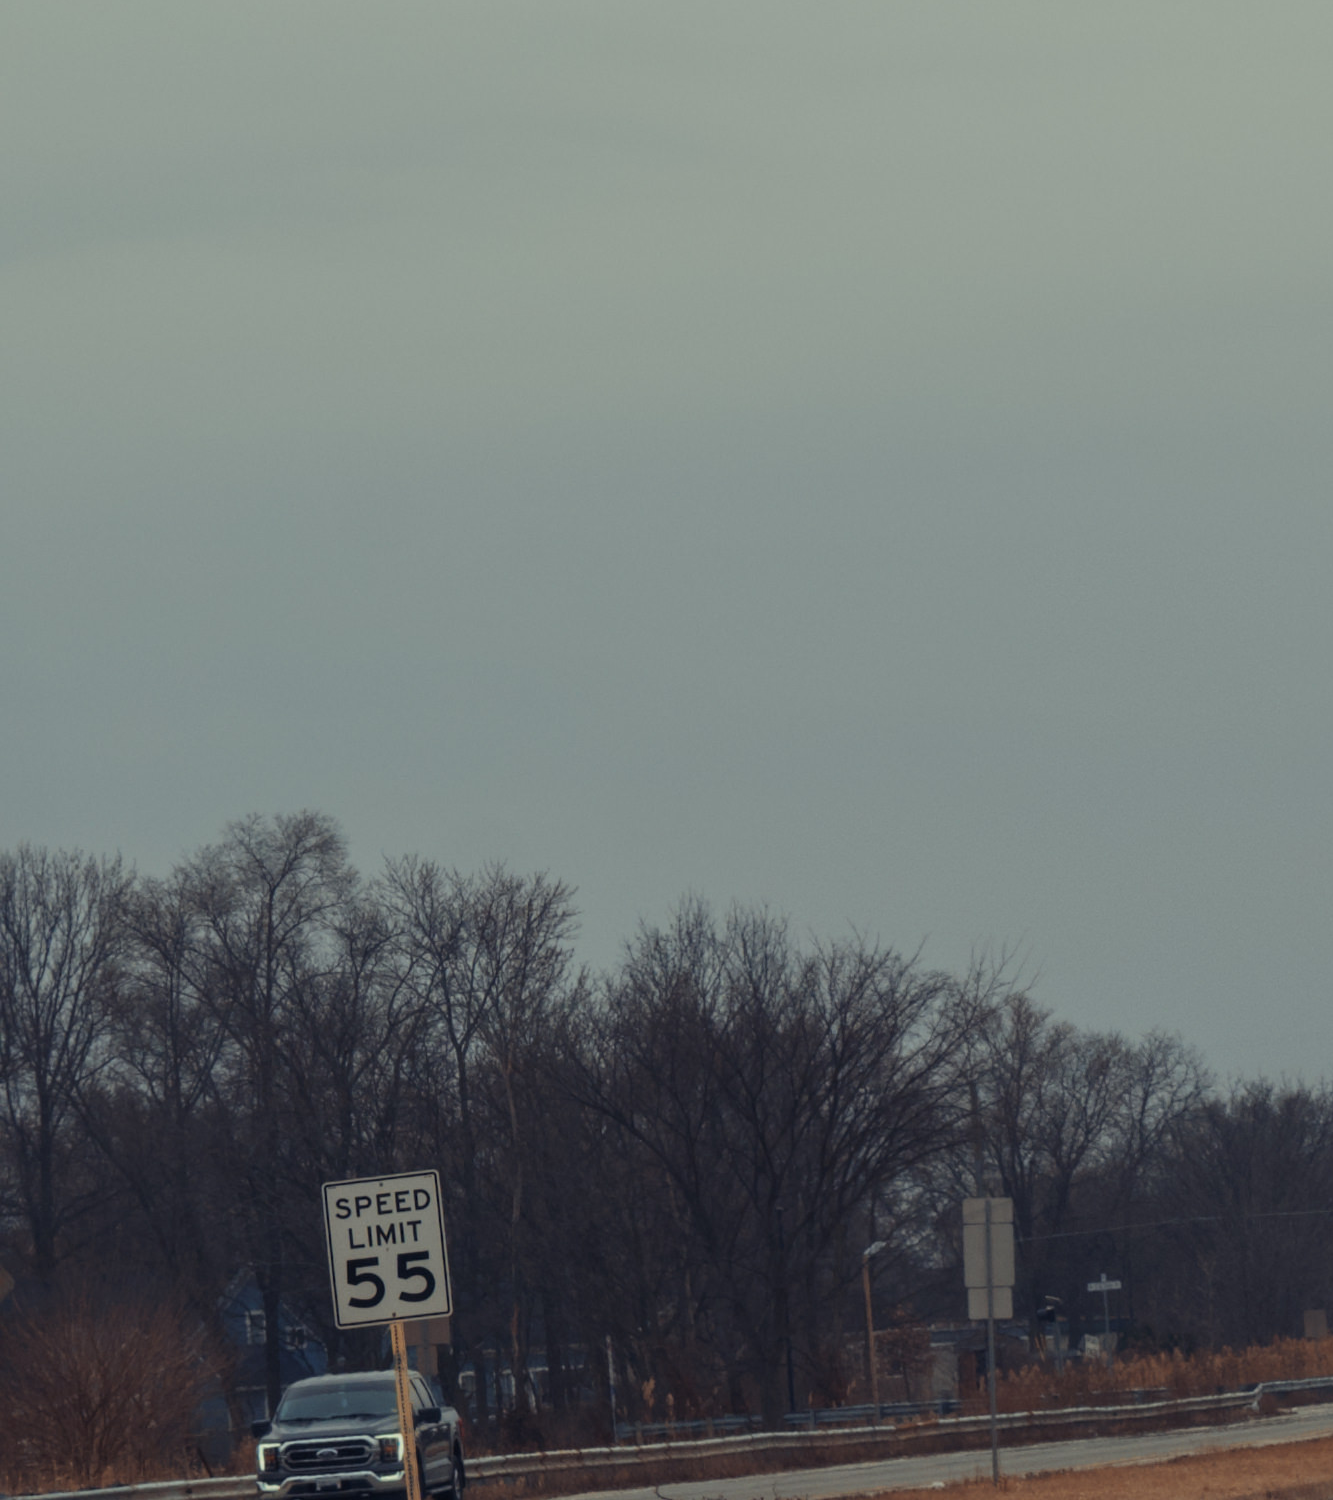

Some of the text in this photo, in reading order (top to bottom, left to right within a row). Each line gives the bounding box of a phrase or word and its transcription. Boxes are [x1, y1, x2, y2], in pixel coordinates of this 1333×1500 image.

[335, 1188, 431, 1219] SPEED
[348, 1219, 422, 1249] LIMIT
[346, 1250, 436, 1309] 55
